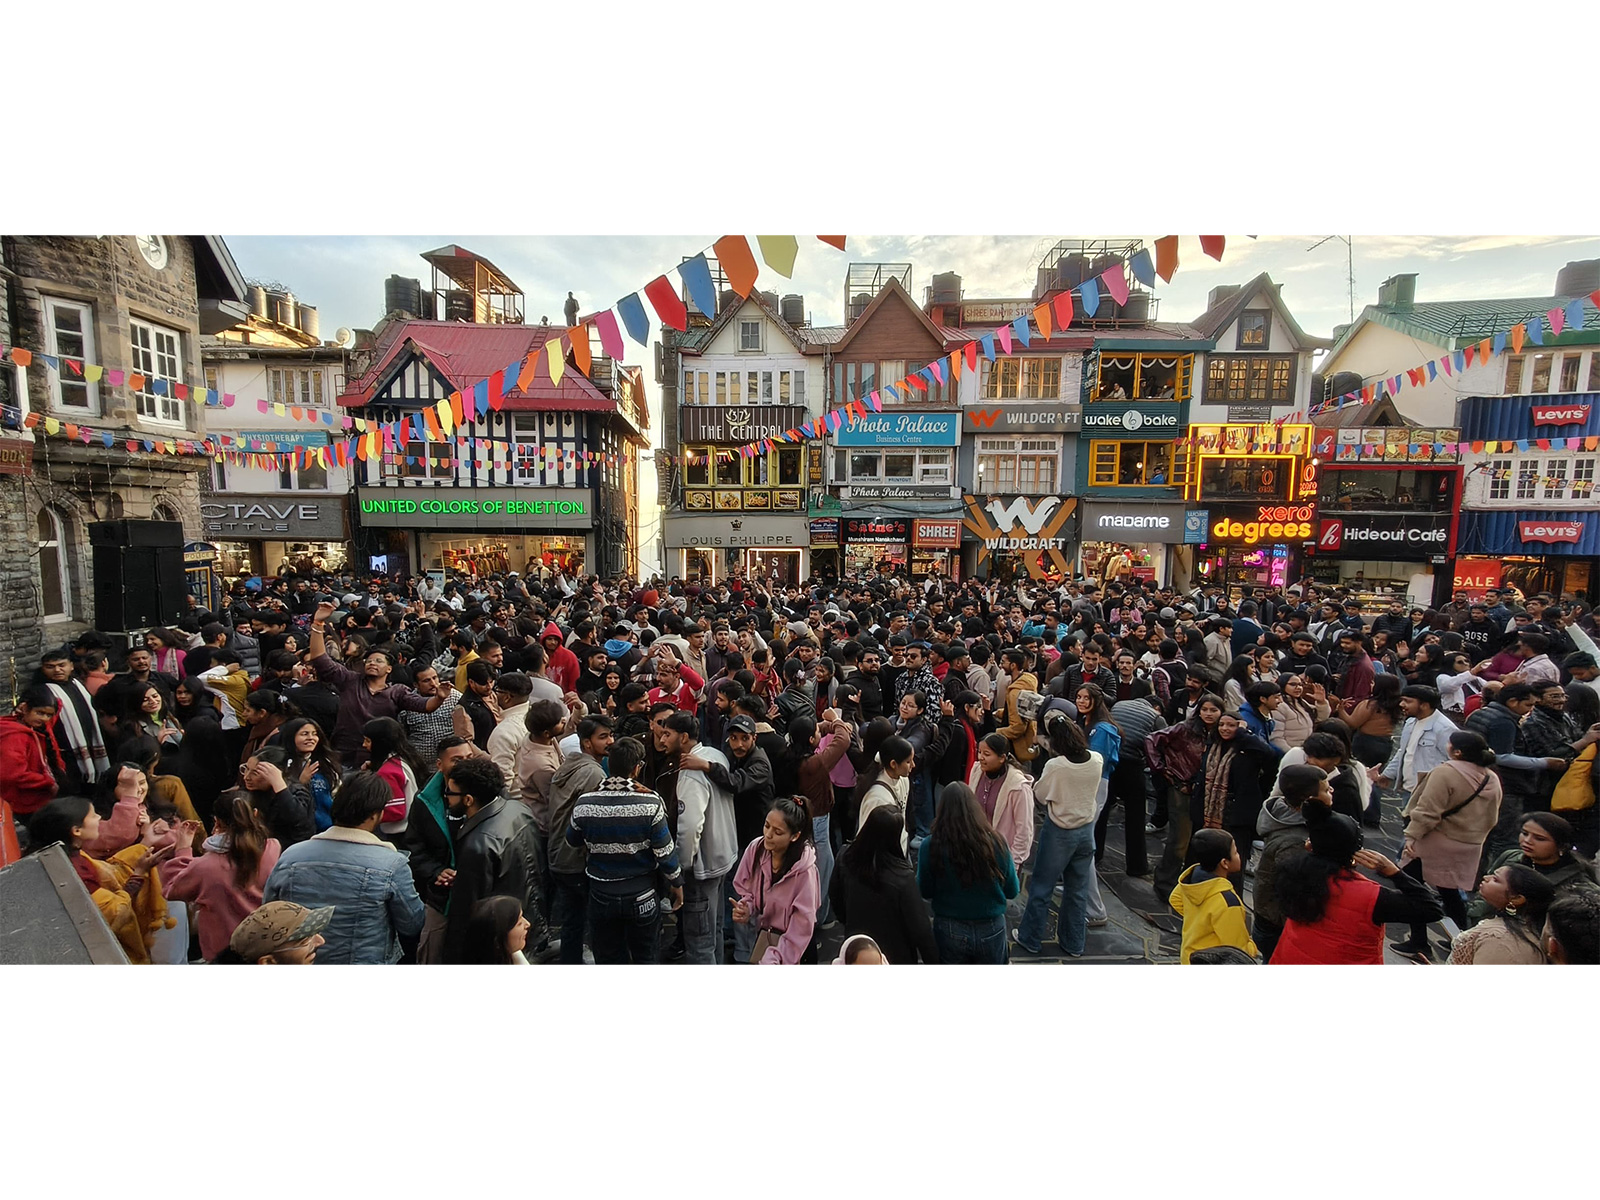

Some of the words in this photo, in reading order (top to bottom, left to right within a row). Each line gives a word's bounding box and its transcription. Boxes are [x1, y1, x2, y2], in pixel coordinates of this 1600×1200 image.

[967, 308, 987, 317] SHREE
[1016, 308, 1034, 316] STUD
[732, 410, 744, 421] 37
[1085, 414, 1121, 426] wake
[1143, 414, 1177, 426] bake
[846, 415, 891, 433] Photo
[895, 415, 948, 433] Palace
[701, 425, 723, 440] THE
[876, 435, 900, 443] Business
[901, 435, 922, 443] Centre
[852, 486, 879, 498] Photo
[882, 486, 914, 498] Palace
[201, 504, 318, 519] CTAVE
[362, 500, 416, 513] UNITED
[421, 500, 478, 513] COLORS
[482, 500, 503, 513] OF
[208, 522, 289, 531] ETTLE
[919, 525, 957, 538] SHREE
[1213, 518, 1311, 544] degrees
[682, 536, 722, 545] LOUIS
[730, 536, 793, 545] PHILIPPE
[1344, 528, 1405, 541] Hideout
[1407, 528, 1447, 542] Café
[985, 538, 1066, 550] WILDCRAFT
[1453, 576, 1495, 587] SALE
[638, 898, 656, 915] DIOR
